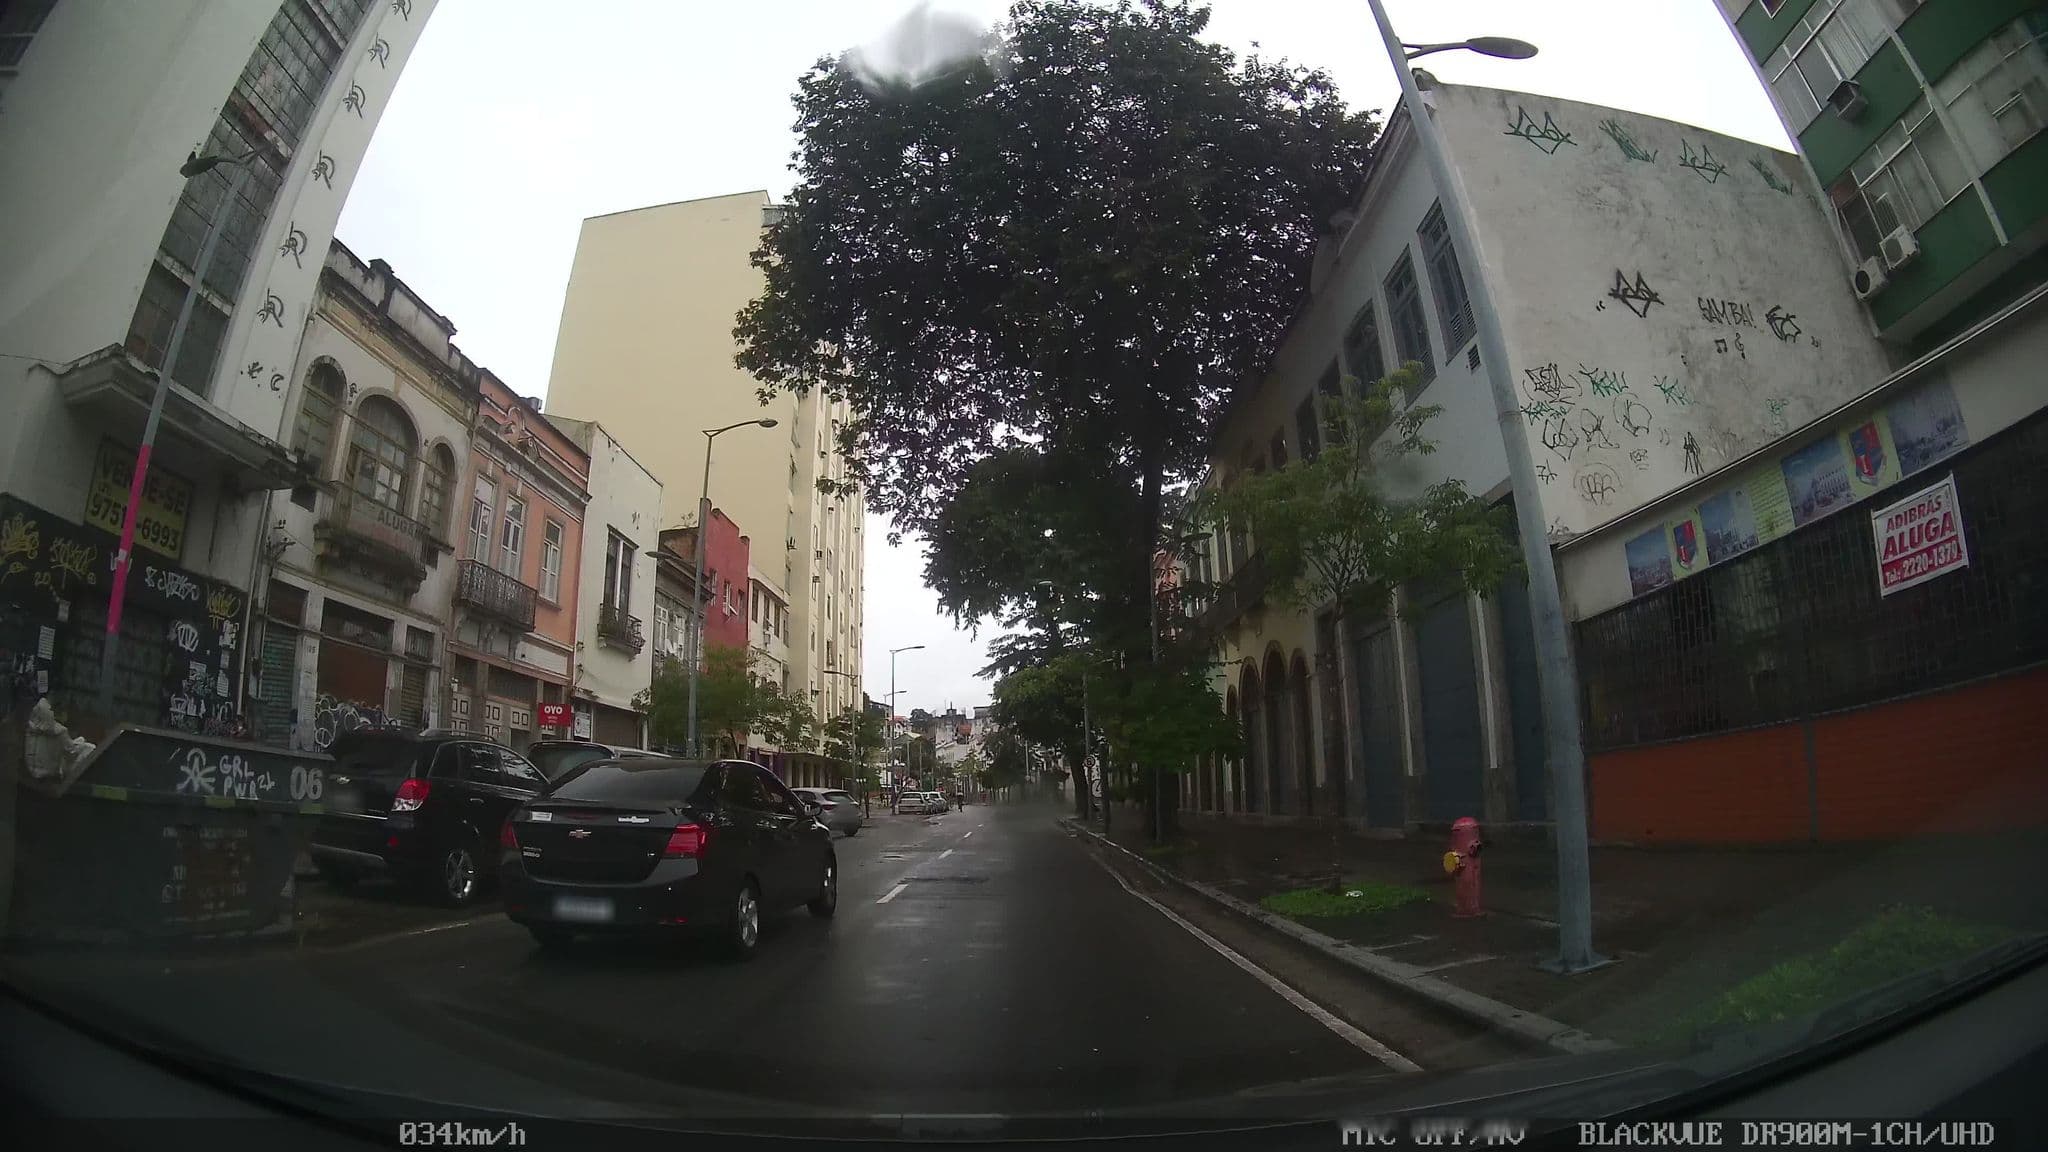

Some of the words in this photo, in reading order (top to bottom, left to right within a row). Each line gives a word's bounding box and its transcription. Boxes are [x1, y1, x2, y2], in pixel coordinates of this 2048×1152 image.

[1886, 494, 1942, 534] ADIBRÁS
[1883, 510, 1956, 560] ALUGA
[544, 705, 563, 715] OYO
[220, 755, 255, 779] GRL
[290, 766, 323, 800] 06
